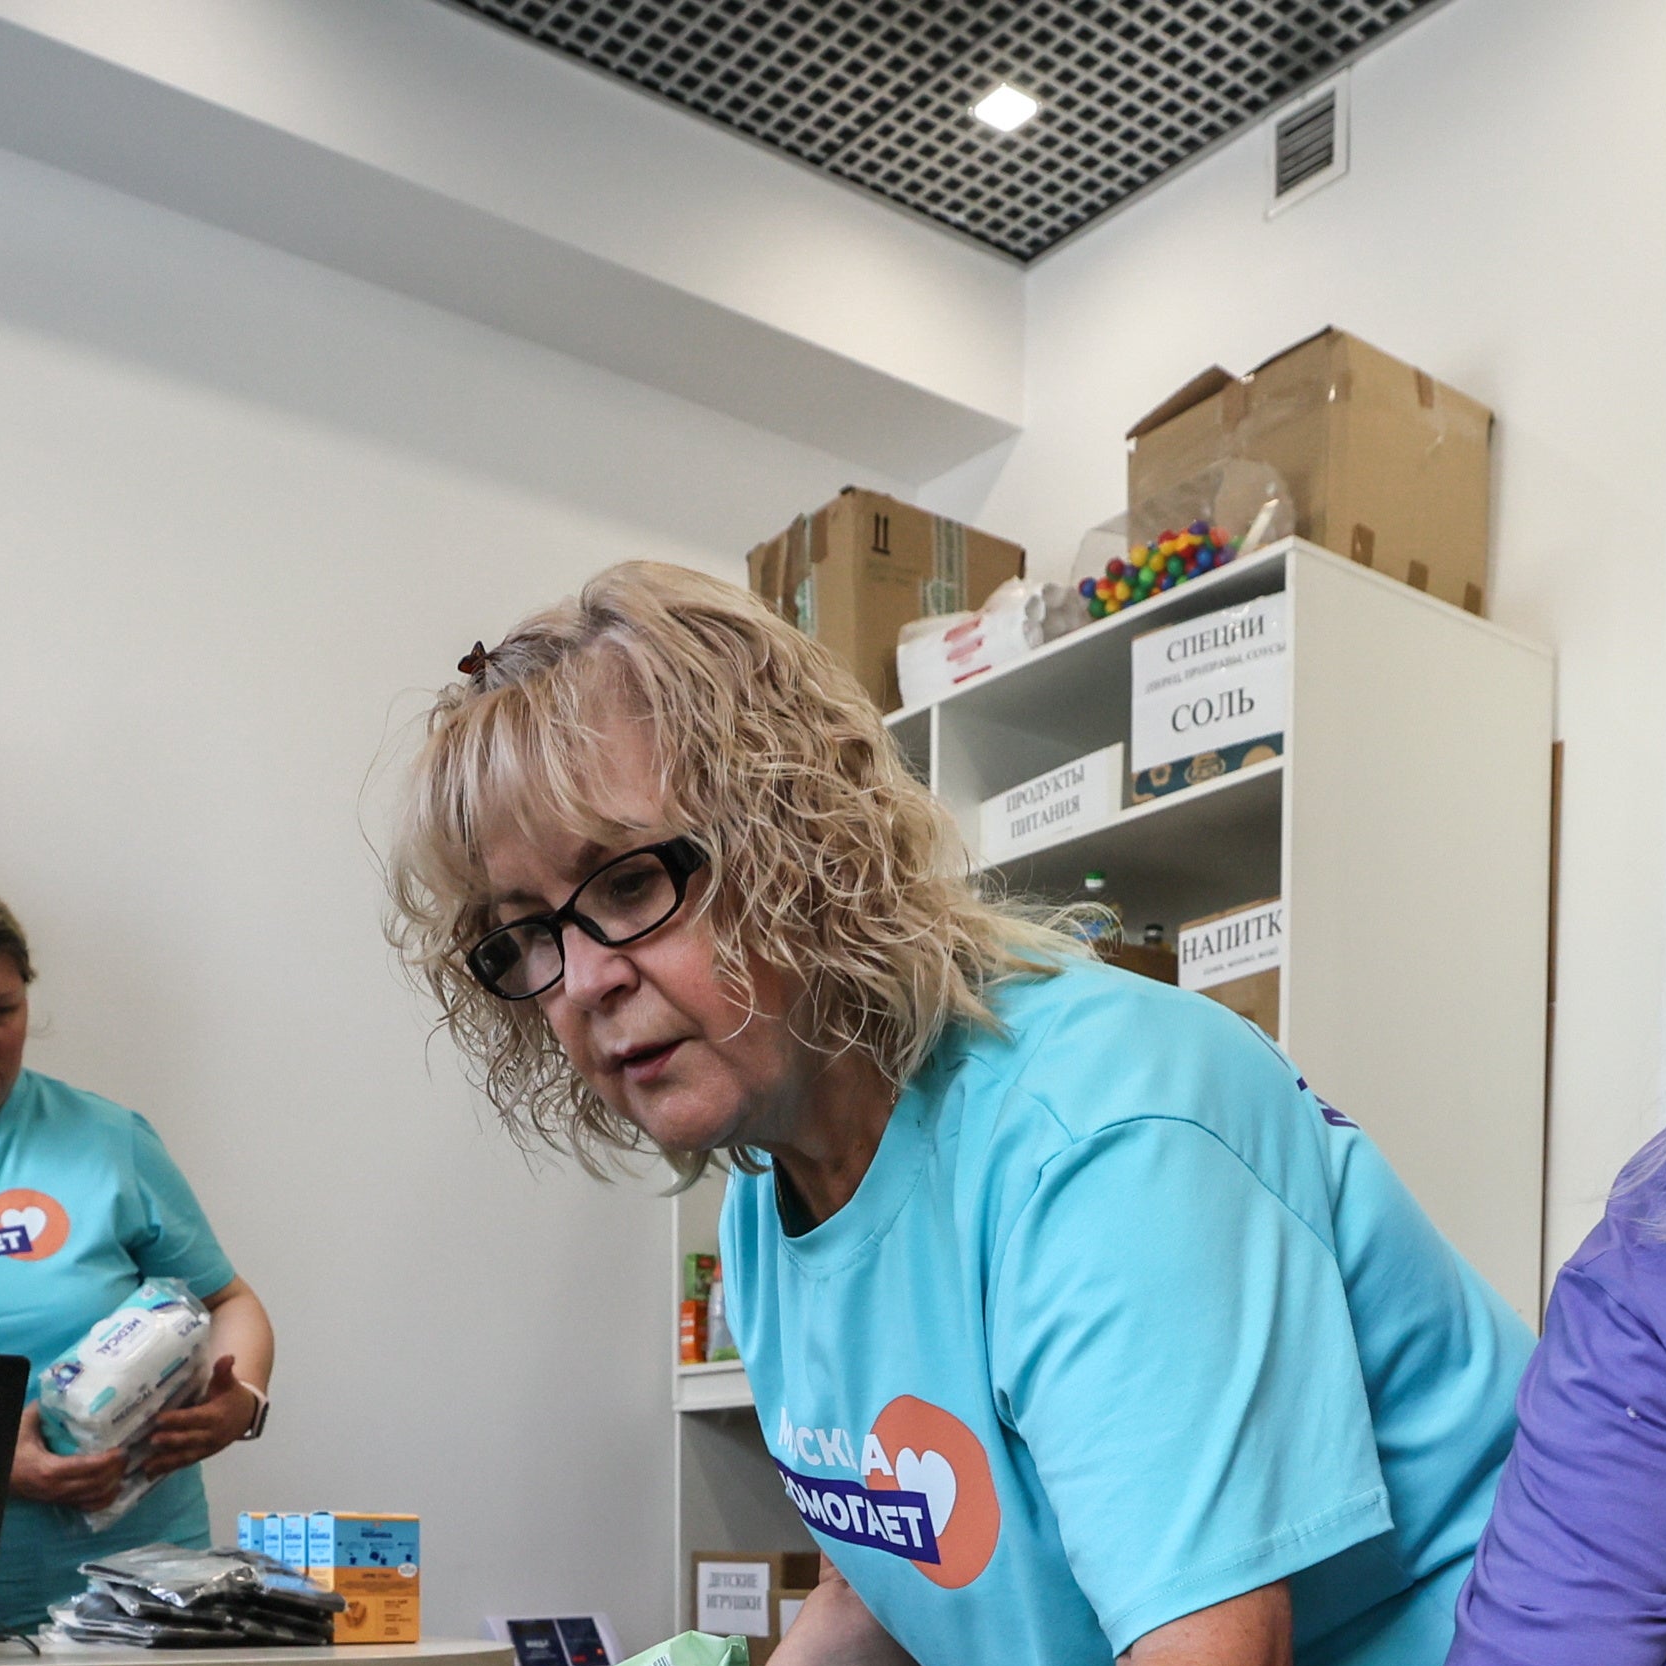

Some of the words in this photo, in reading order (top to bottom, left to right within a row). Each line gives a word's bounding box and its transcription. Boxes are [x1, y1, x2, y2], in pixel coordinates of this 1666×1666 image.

[1166, 614, 1265, 664] СПЕЦИИ
[1171, 687, 1255, 733] СОЛЬ
[1005, 763, 1085, 814] ПРОДУКТЫ
[1010, 794, 1081, 839] ПИТАНИЯ
[1181, 908, 1283, 966] НАПИТК
[777, 1406, 894, 1477] МСКА
[778, 1469, 923, 1549] ОМОГАЕТ
[706, 1593, 761, 1611] ИГРУШКИ
[708, 1571, 758, 1589] ДЕТСКИЕ
